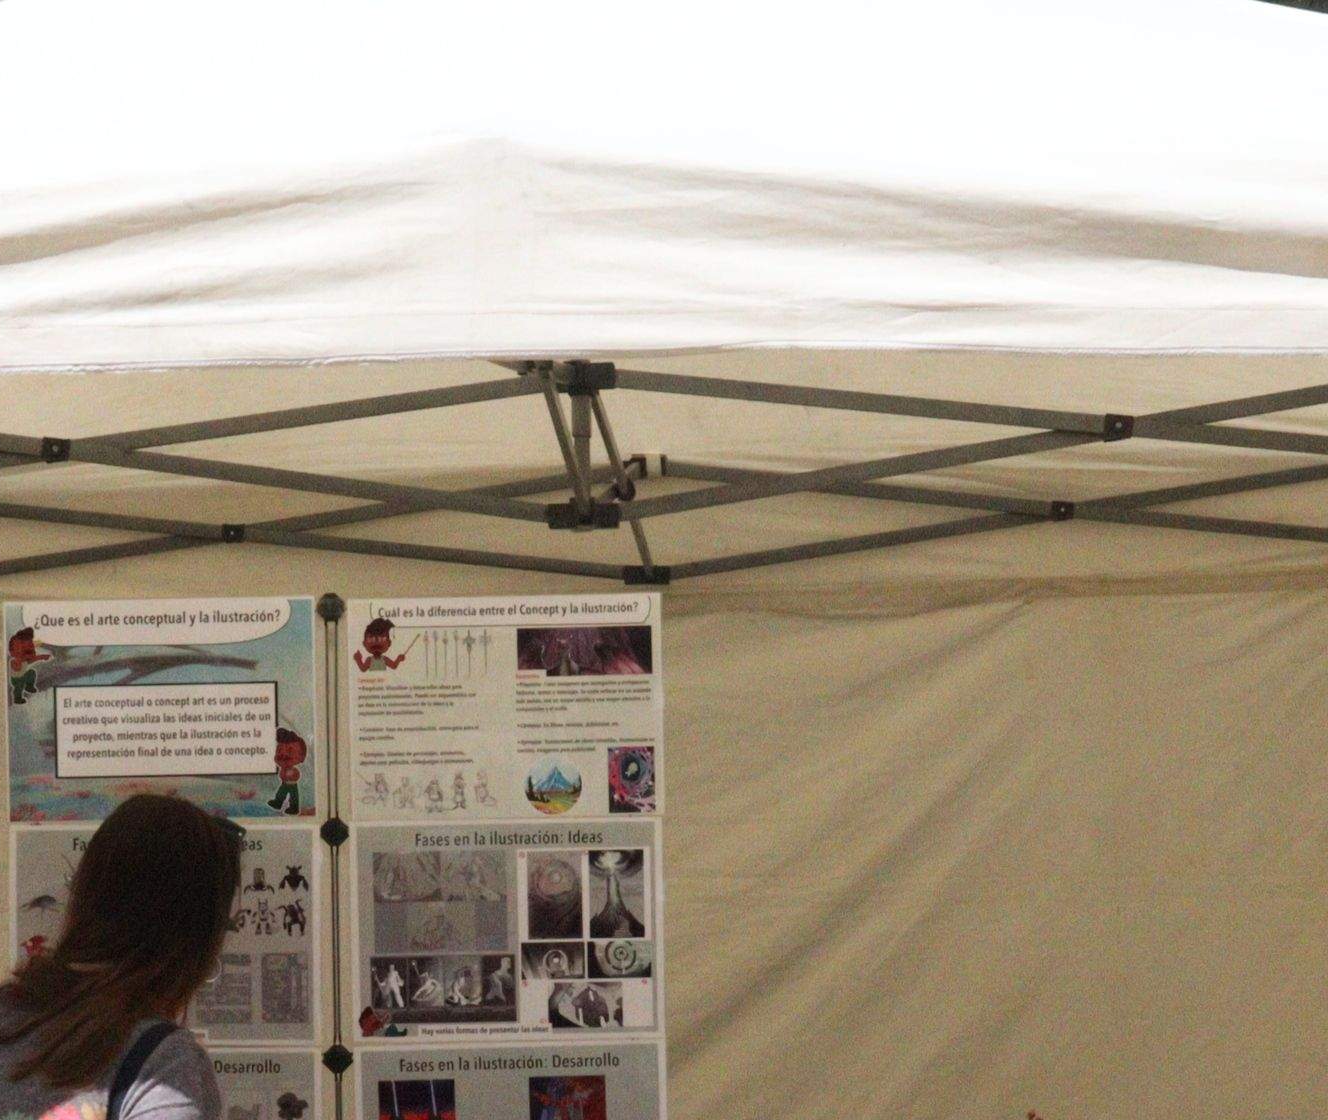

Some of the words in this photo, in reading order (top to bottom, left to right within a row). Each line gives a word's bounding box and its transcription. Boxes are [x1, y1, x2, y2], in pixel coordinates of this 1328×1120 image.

[402, 608, 413, 617] es
[416, 605, 425, 617] la
[427, 605, 476, 617] diferencia
[479, 606, 505, 616] entre
[507, 604, 517, 615] el
[519, 604, 559, 617] Concept
[561, 606, 567, 616] y
[570, 602, 578, 614] la
[68, 616, 80, 626] es
[83, 613, 93, 625] el
[97, 615, 120, 626] arte
[123, 611, 186, 628] conceptual
[189, 615, 196, 627] y
[199, 610, 209, 623] la
[212, 609, 280, 623] ilustración?
[63, 697, 72, 708] El
[74, 699, 92, 708] arte
[94, 696, 144, 709] conceptual
[155, 697, 190, 708] concept
[192, 697, 204, 706] art
[219, 697, 232, 705] un
[234, 696, 270, 706] proceso
[63, 715, 99, 725] creativo
[101, 716, 118, 726] que
[121, 713, 160, 724] visualiza
[163, 713, 175, 723] las
[178, 712, 202, 722] ideas
[204, 712, 242, 722] iniciales
[245, 711, 256, 721] de
[259, 713, 271, 721] un
[117, 731, 158, 741] mientras
[160, 731, 177, 742] que
[179, 729, 188, 739] la
[191, 729, 238, 739] ilustración
[241, 730, 251, 738] es
[253, 728, 262, 738] la
[67, 748, 135, 760] representación
[137, 746, 159, 757] final
[161, 746, 172, 757] de
[174, 748, 192, 756] una
[194, 746, 214, 756] idea
[216, 747, 222, 755] o
[224, 746, 268, 757] concepto.
[414, 833, 450, 847] Fases
[454, 835, 470, 846] en
[474, 832, 486, 845] la
[489, 831, 564, 845] ilustración:
[568, 830, 604, 844] Ideas
[214, 1060, 280, 1073] Desarrollo
[399, 1059, 435, 1072] Fases
[438, 1060, 454, 1071] en
[458, 1056, 470, 1071] la
[552, 1053, 620, 1069] Desarrollo
